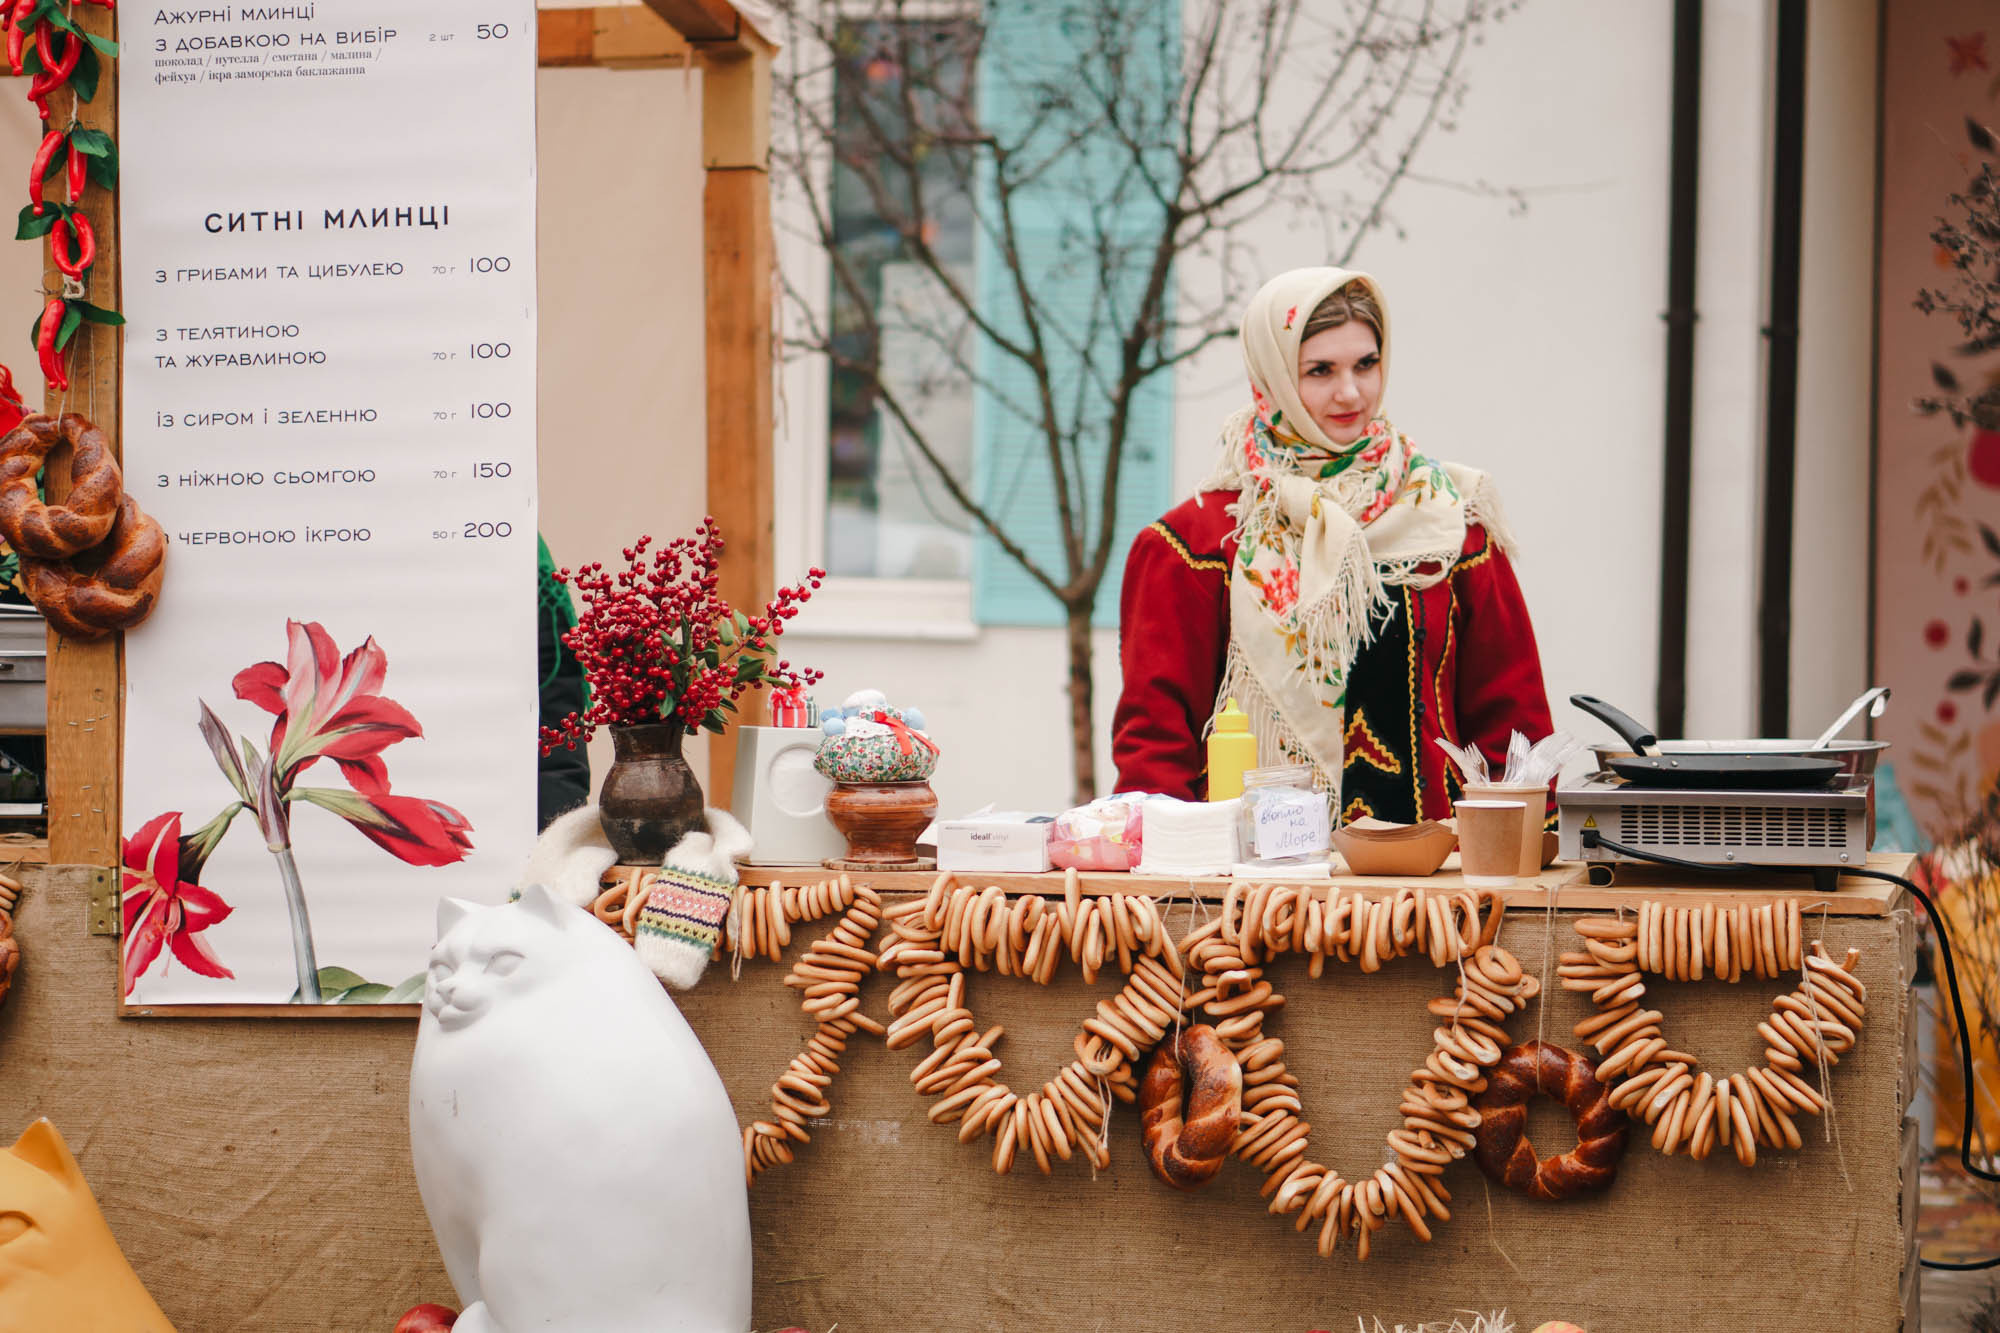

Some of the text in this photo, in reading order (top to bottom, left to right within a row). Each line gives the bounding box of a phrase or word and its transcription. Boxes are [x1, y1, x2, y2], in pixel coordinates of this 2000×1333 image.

[175, 34, 291, 53] ДОБАВКОЮ
[300, 33, 327, 46] НА
[428, 33, 437, 42] 2
[476, 23, 510, 40] 50
[154, 56, 203, 68] шоколад
[215, 55, 260, 67] нутелла
[272, 52, 318, 63] сметана
[331, 50, 373, 61] малина
[154, 72, 196, 86] фейхуа
[208, 70, 232, 83] ікра
[234, 68, 293, 82] заморська
[295, 66, 366, 79] баклажанна
[204, 204, 449, 234] СИТНІ МЛИНЦІ
[176, 266, 267, 283] ГРИБАМИ
[276, 265, 300, 280] ТА
[308, 262, 404, 281] ЦИБУЛЕЮ
[431, 266, 447, 275] 70
[470, 256, 512, 274] 100
[176, 324, 300, 342] ТЕЛЯТИНОЮ
[154, 355, 177, 369] ТА
[185, 350, 327, 369] ЖУРАВЛИНОЮ
[431, 351, 447, 361] 70
[470, 342, 512, 360] 100
[183, 411, 254, 427] СИРОМ
[277, 408, 378, 425] ЗЕЛЕННЮ
[432, 411, 448, 421] 70
[471, 401, 512, 419] 100
[273, 469, 376, 485] СЬОМГОЮ
[432, 470, 448, 480] 70
[473, 461, 512, 479] 150
[179, 529, 296, 545] ЧЕРВОНОЮ
[432, 530, 448, 540] 50
[463, 521, 513, 538] 200
